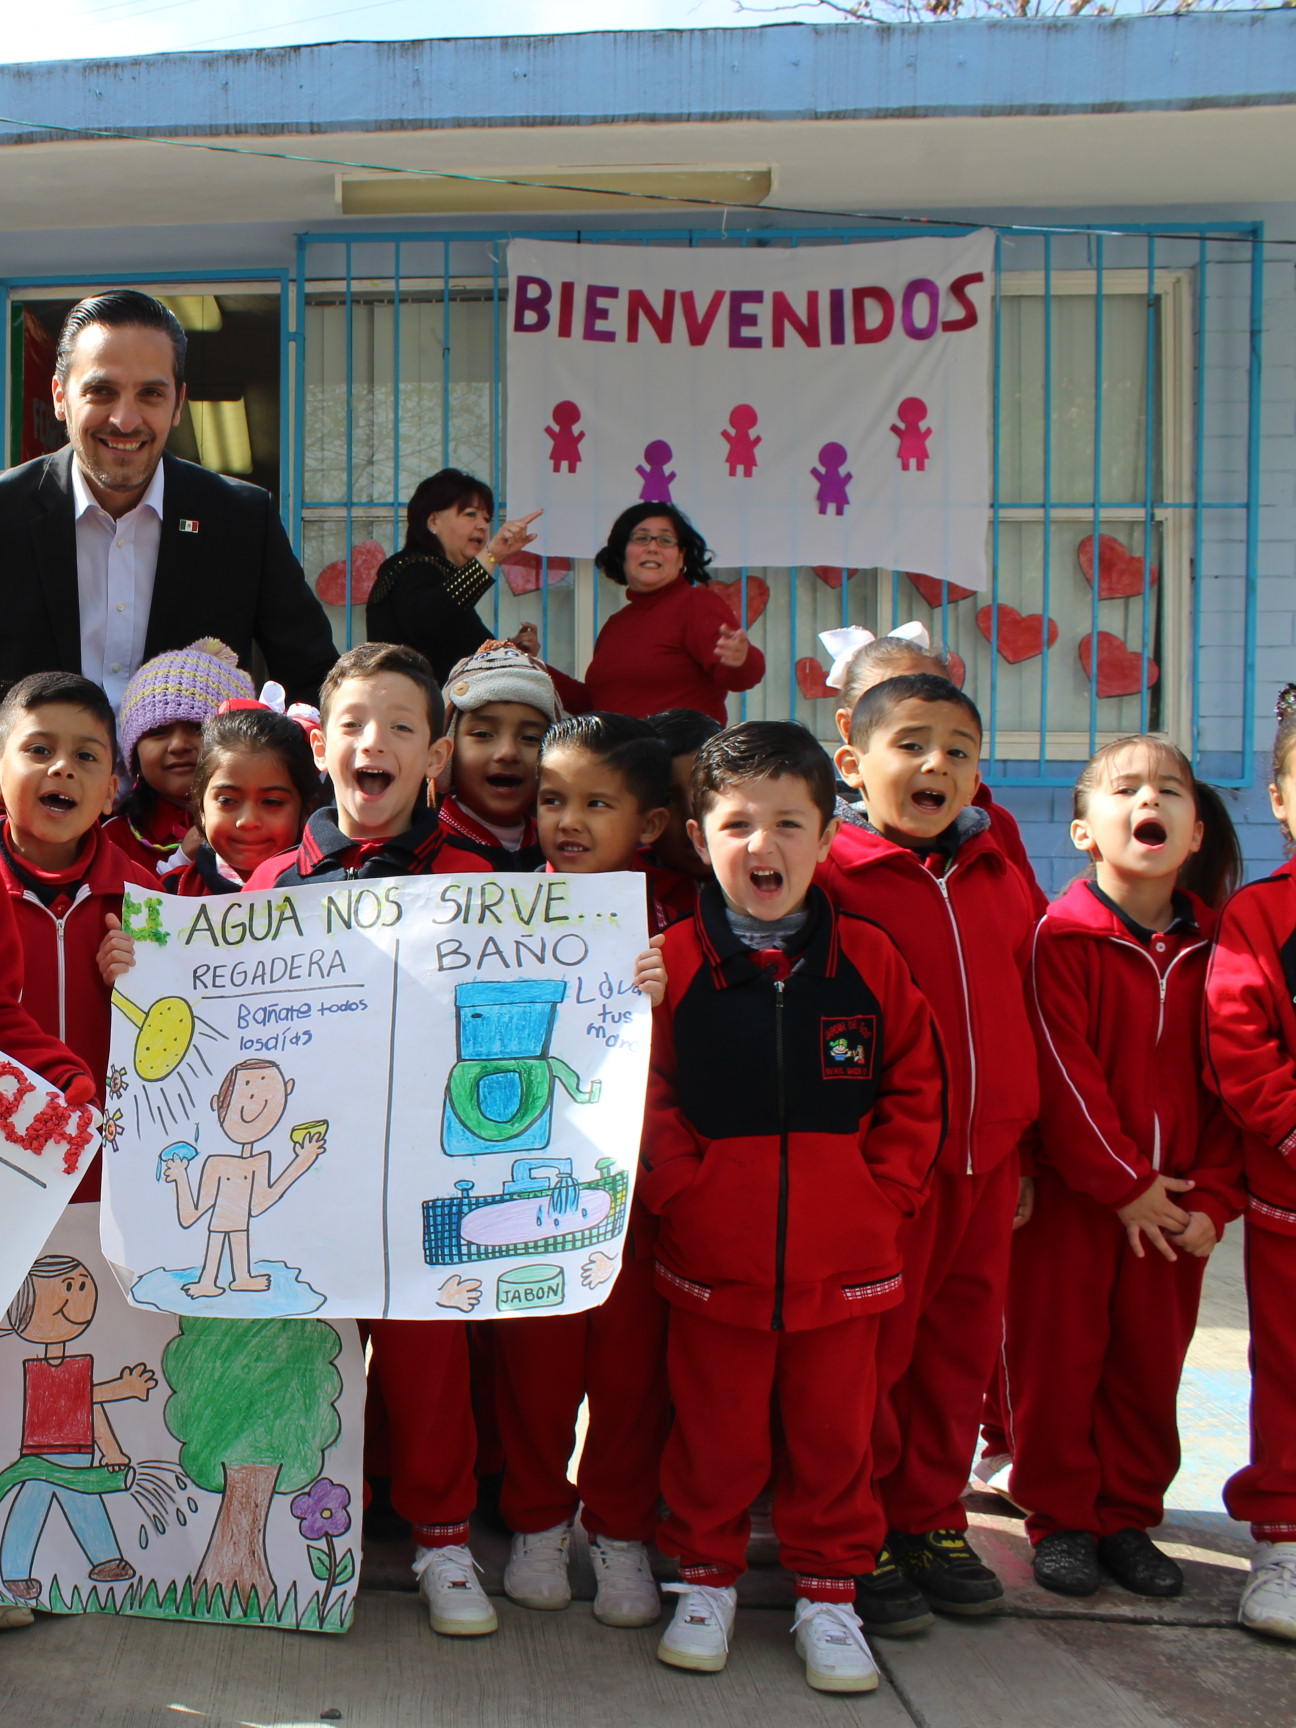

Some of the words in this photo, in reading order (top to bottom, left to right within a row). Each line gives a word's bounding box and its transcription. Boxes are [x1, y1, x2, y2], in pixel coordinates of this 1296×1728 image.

[513, 271, 984, 348] BIENVENIDOS
[185, 895, 304, 947] AGUA
[326, 886, 403, 934] NOS
[192, 949, 346, 990] REGADERA
[436, 933, 589, 972] BAÑO
[237, 1002, 312, 1030] Bañate
[317, 999, 368, 1017] todos
[598, 1004, 633, 1024] tus
[500, 1283, 560, 1304] JABON
